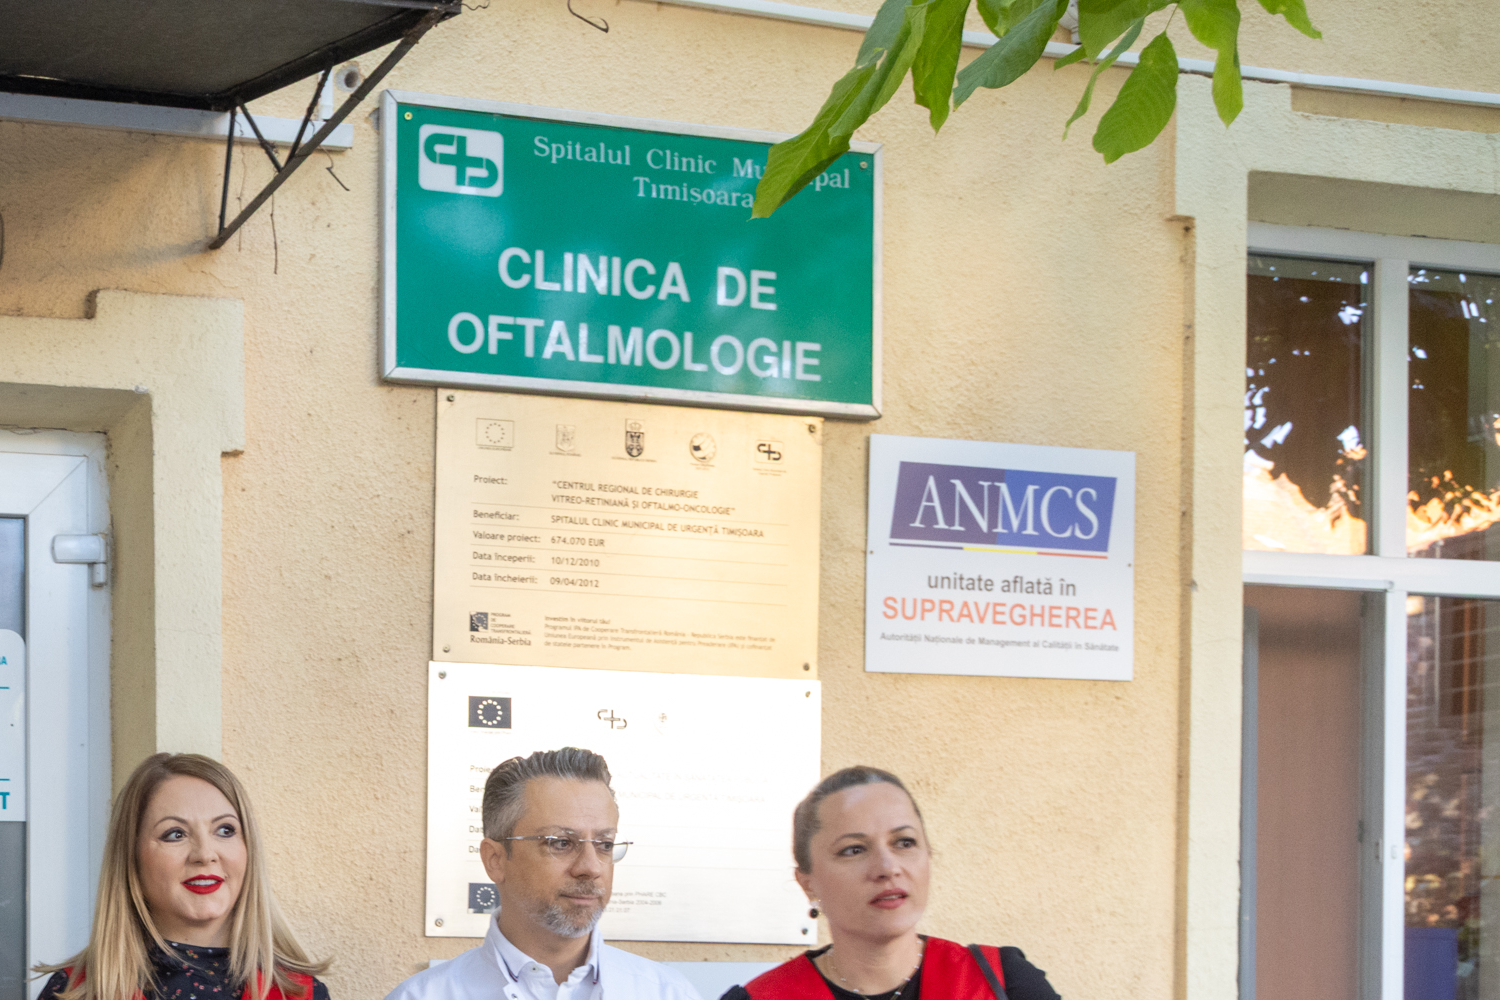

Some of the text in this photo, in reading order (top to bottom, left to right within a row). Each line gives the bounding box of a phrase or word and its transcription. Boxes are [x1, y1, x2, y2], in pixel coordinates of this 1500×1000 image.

[534, 136, 850, 192] Spitalul Clinic Mupal
[498, 246, 777, 310] CLINICA DE
[447, 311, 821, 381] OFTALMOLOGIE
[598, 484, 639, 495] REGIONAL
[642, 487, 652, 496] DE
[655, 488, 699, 499] CHIRURGIE
[910, 474, 1099, 540] ANMCS
[473, 510, 519, 521] Beneficiar:
[551, 515, 589, 526] SPITALUL
[592, 517, 619, 528] CLINIC
[621, 521, 665, 531] MUNICIPAL
[667, 523, 677, 531] DE
[473, 531, 505, 540] Valoare
[588, 538, 605, 547] EUR
[473, 551, 492, 560] Data
[551, 557, 600, 567] 10/12/2010
[472, 572, 491, 581] Data
[550, 577, 599, 588] 09/04/2012
[928, 572, 1076, 596] unitate aflată în
[882, 596, 1118, 631] SUPRAVEGHEREA
[470, 635, 532, 646] România-Serbia
